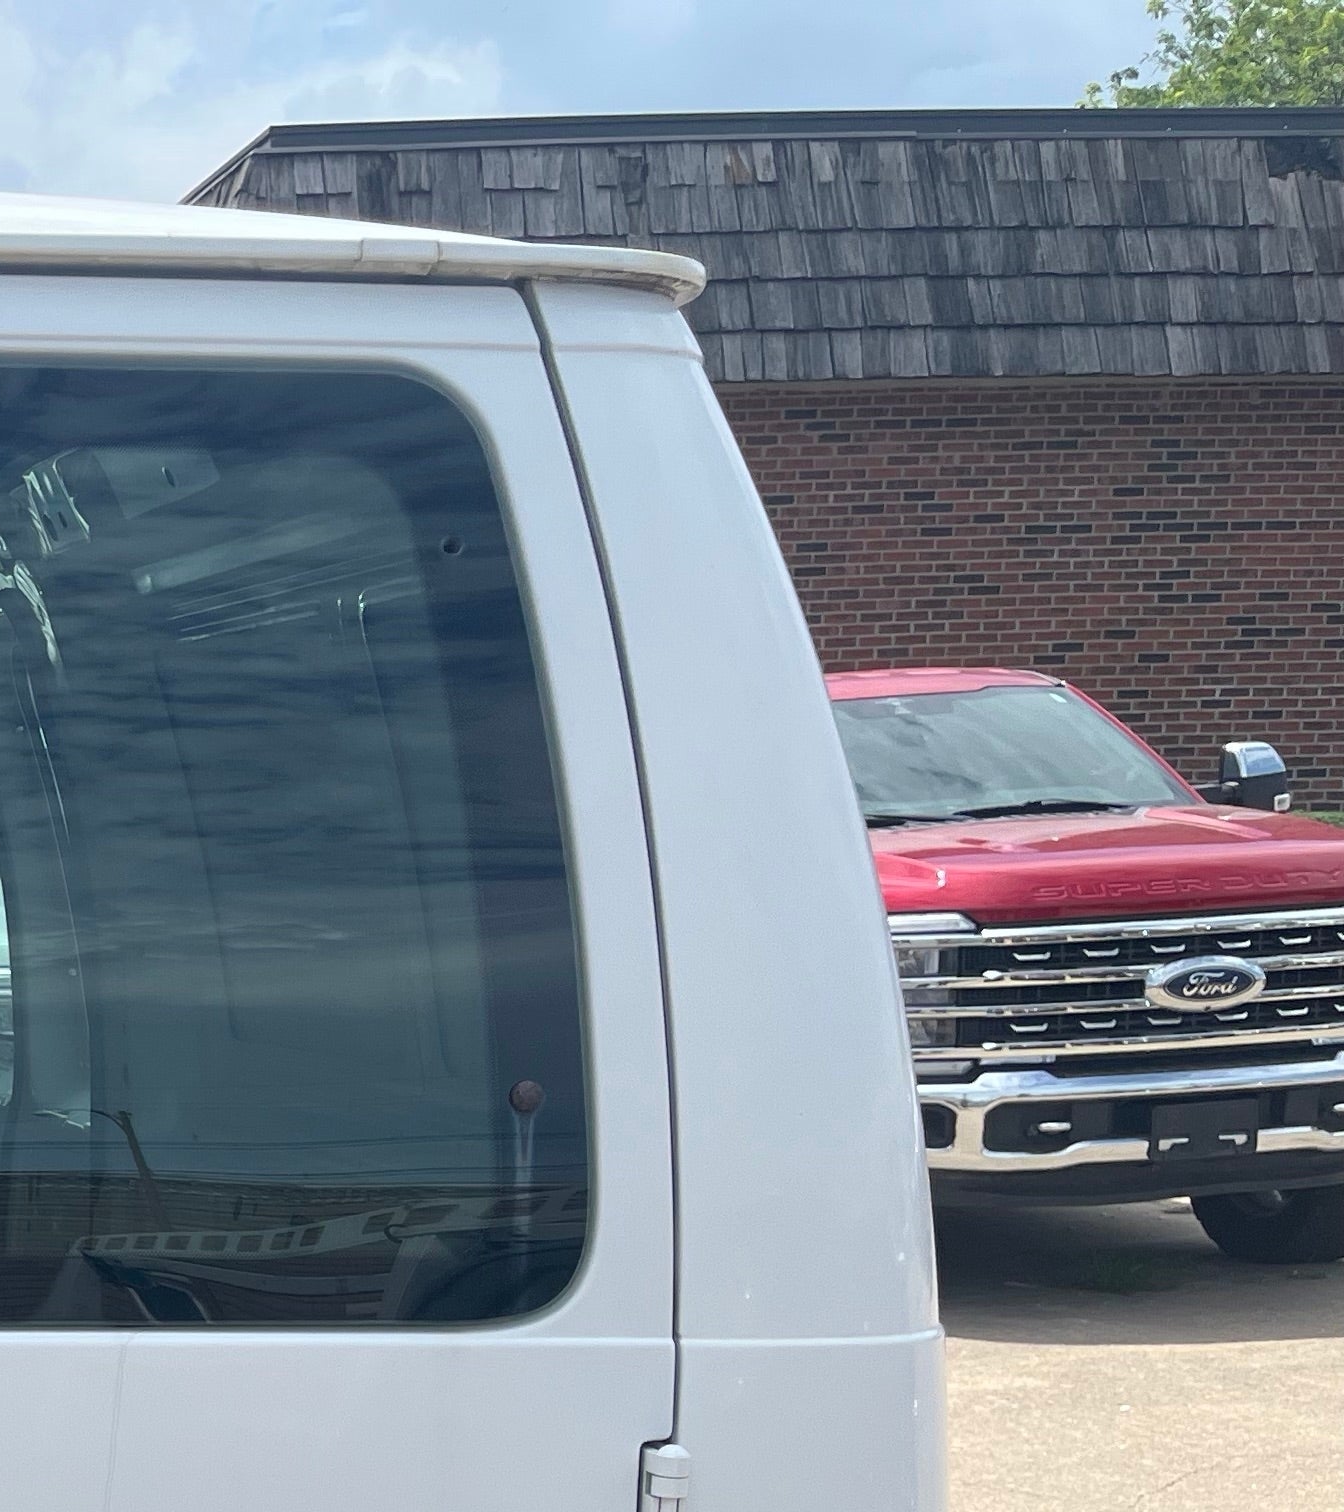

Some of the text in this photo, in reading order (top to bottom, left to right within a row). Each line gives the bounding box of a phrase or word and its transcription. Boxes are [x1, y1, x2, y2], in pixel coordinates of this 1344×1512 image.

[1033, 867, 1344, 901] SUPER DUTY
[1182, 971, 1239, 997] Ford
